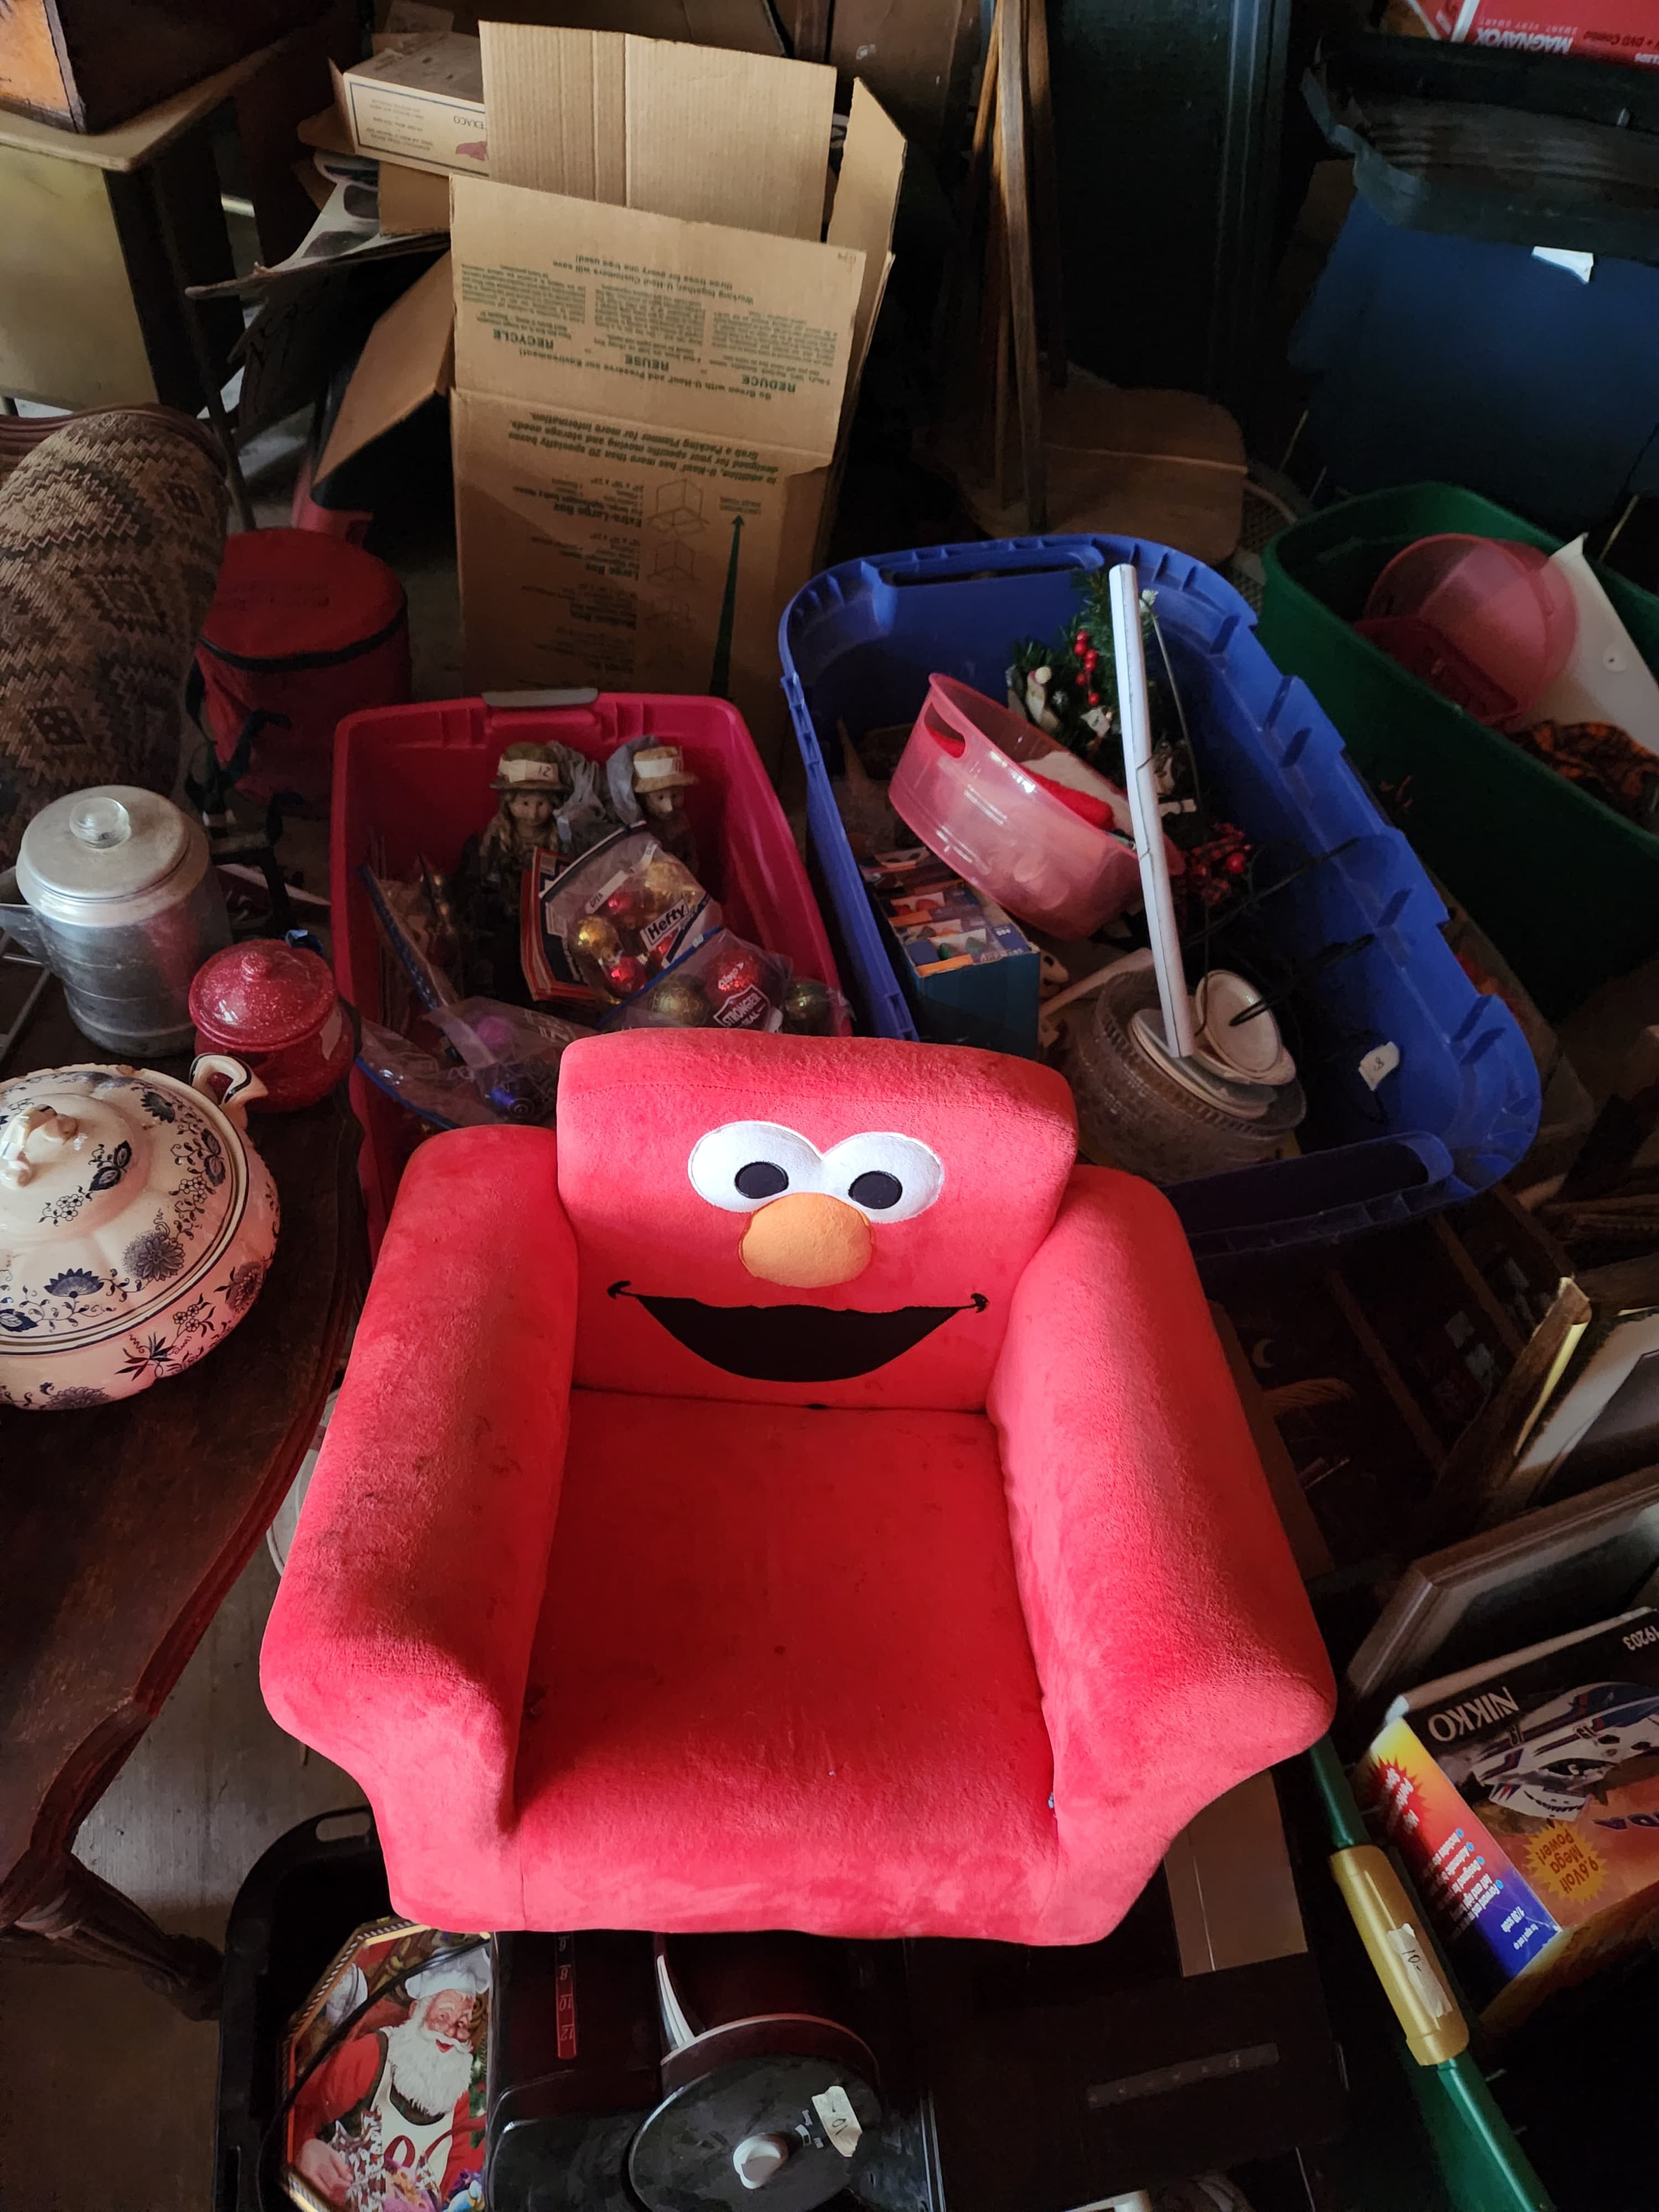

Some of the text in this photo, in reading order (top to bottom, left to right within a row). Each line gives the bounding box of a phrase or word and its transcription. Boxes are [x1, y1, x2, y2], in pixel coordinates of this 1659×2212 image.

[1478, 28, 1573, 54] MAGNAVOX
[452, 114, 484, 129] EXACO
[491, 328, 554, 349] RECYCLE
[624, 354, 670, 371] REUSE
[741, 374, 796, 392] REDUCE
[645, 904, 690, 940] Hefty
[722, 993, 761, 1026] STRONGER
[1428, 1686, 1519, 1744] NIKKO
[1532, 1828, 1577, 1865] Power!
[1546, 1841, 1584, 1875] Mega
[560, 1968, 567, 1980] 8
[559, 1997, 571, 2011] 10
[560, 2028, 572, 2040] 12
